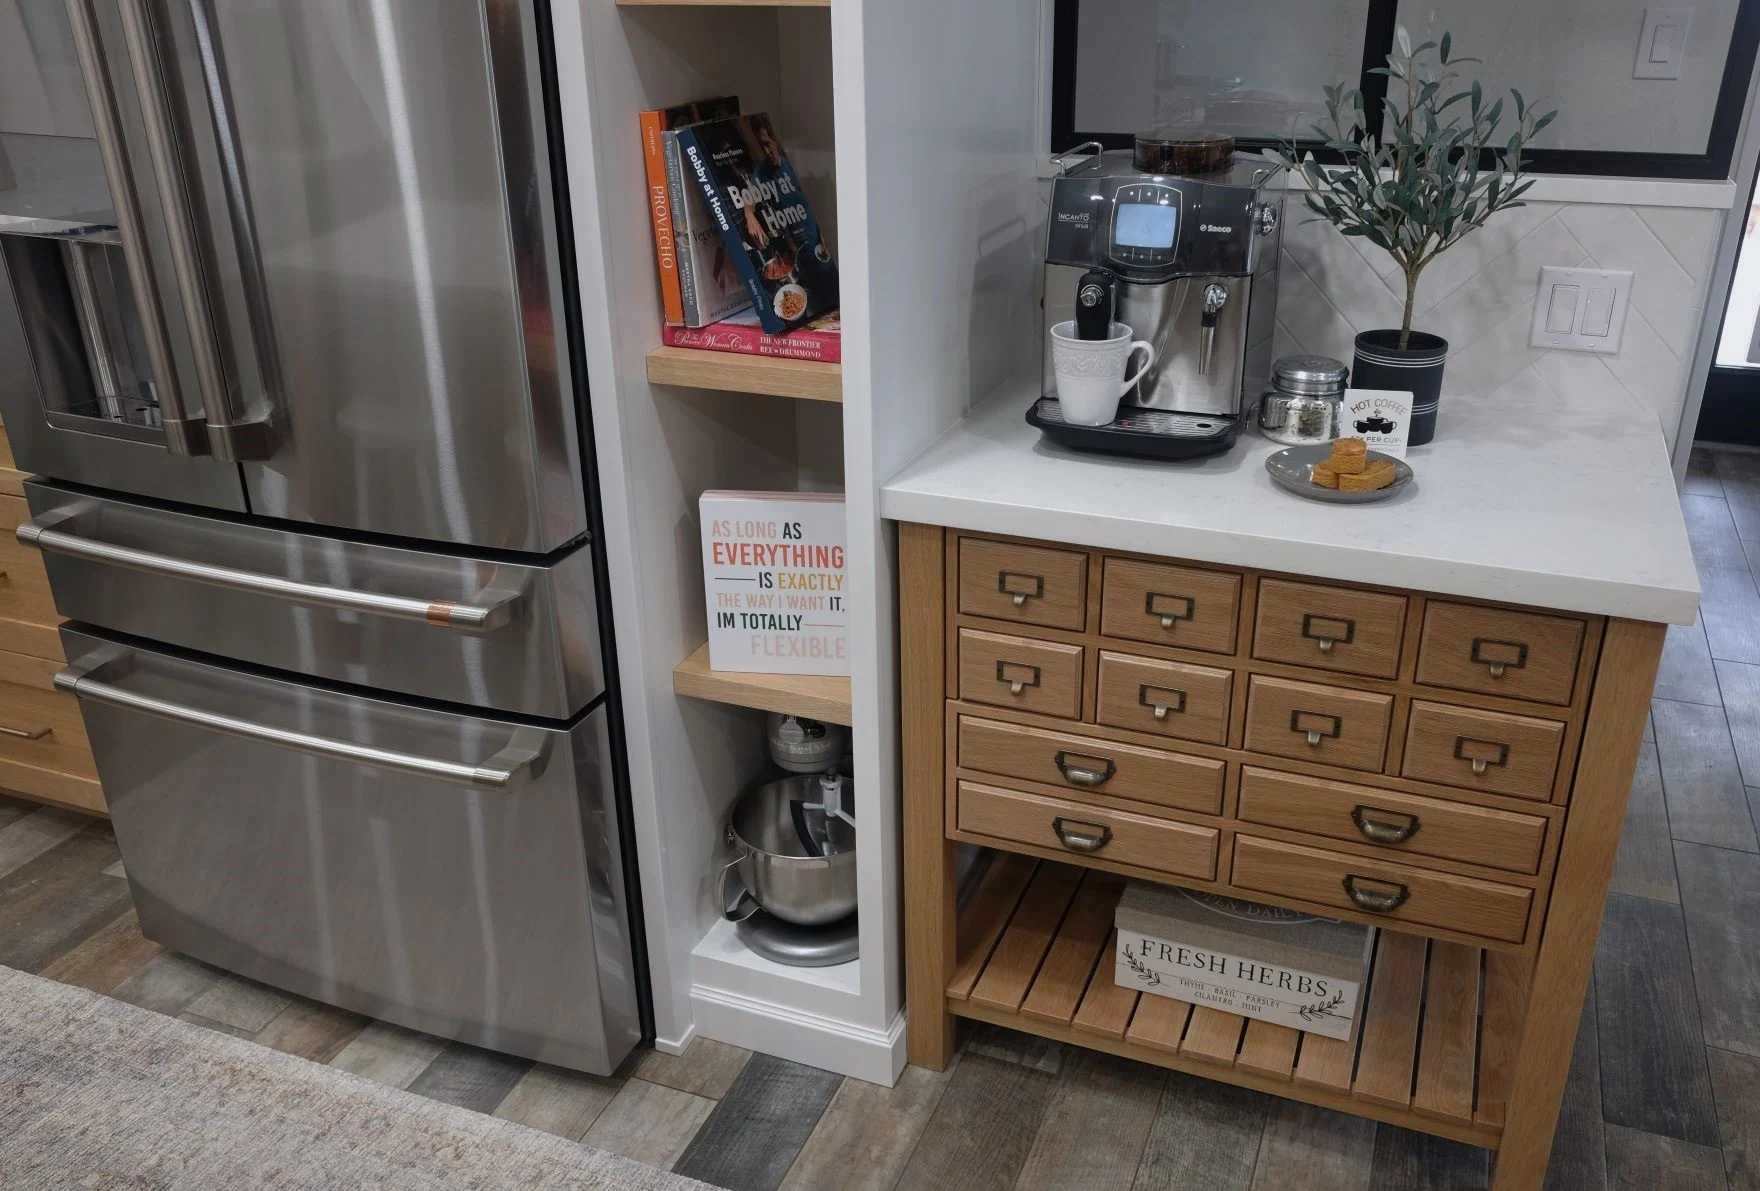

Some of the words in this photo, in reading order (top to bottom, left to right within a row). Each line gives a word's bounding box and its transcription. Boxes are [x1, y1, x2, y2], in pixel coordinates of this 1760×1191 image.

[665, 140, 675, 181] Vegetarian
[670, 183, 681, 217] Cooking
[686, 145, 708, 183] Bobby
[703, 183, 715, 197] at
[709, 196, 730, 231] Home
[727, 176, 779, 210] Bobby
[778, 172, 796, 195] at
[652, 185, 674, 269] PROVECHO
[761, 202, 808, 238] Home
[1058, 211, 1090, 221] INCANTO
[1207, 224, 1232, 233] Saeco
[674, 329, 701, 345] Pioneer
[700, 332, 730, 348] Woman
[727, 333, 753, 351] Cooks
[760, 336, 773, 345] THE
[773, 337, 787, 346] NEW
[788, 338, 821, 349] FRONTIER
[760, 345, 773, 354] REE
[779, 347, 821, 358] DRUMMOND
[1350, 399, 1371, 414] HOT
[1374, 398, 1408, 416] COFFEE
[712, 520, 731, 538] AS
[736, 520, 777, 539] LONG
[782, 522, 803, 540] AS
[712, 542, 844, 569] EVERYTHING
[758, 571, 773, 589] IS
[778, 572, 844, 591] EXACTLY
[716, 592, 741, 608] THE
[745, 593, 774, 609] WAY
[778, 594, 783, 610] I
[786, 595, 826, 611] WANT
[716, 611, 736, 629] IM
[739, 612, 803, 631] TOTALLY
[750, 634, 847, 660] FLEXIBLE
[1139, 938, 1227, 975] FRESH
[1236, 961, 1329, 998] HERBS
[1179, 978, 1205, 991] THYME
[1214, 987, 1236, 998] BASIL
[1245, 994, 1281, 1008] PARSLEY
[1194, 991, 1233, 1006] CILANTRO
[1241, 1002, 1262, 1013] MINT
